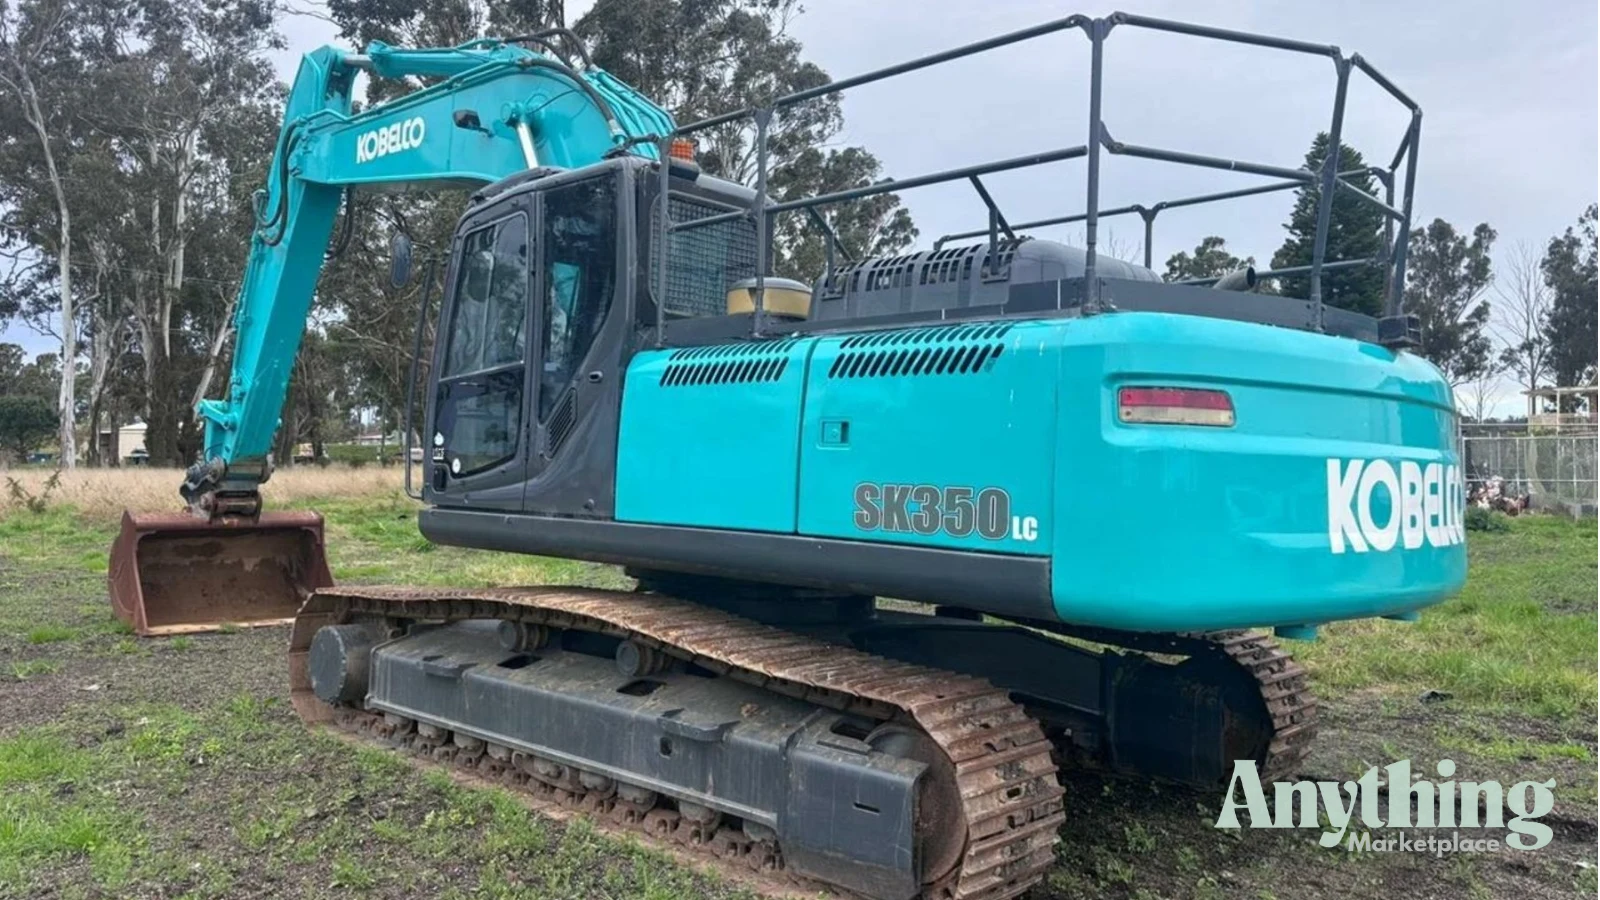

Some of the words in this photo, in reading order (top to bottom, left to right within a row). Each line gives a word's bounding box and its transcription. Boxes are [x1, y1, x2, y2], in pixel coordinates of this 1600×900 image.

[356, 116, 425, 164] KOBELCO
[853, 482, 1011, 540] SK350
[1012, 516, 1038, 541] LC
